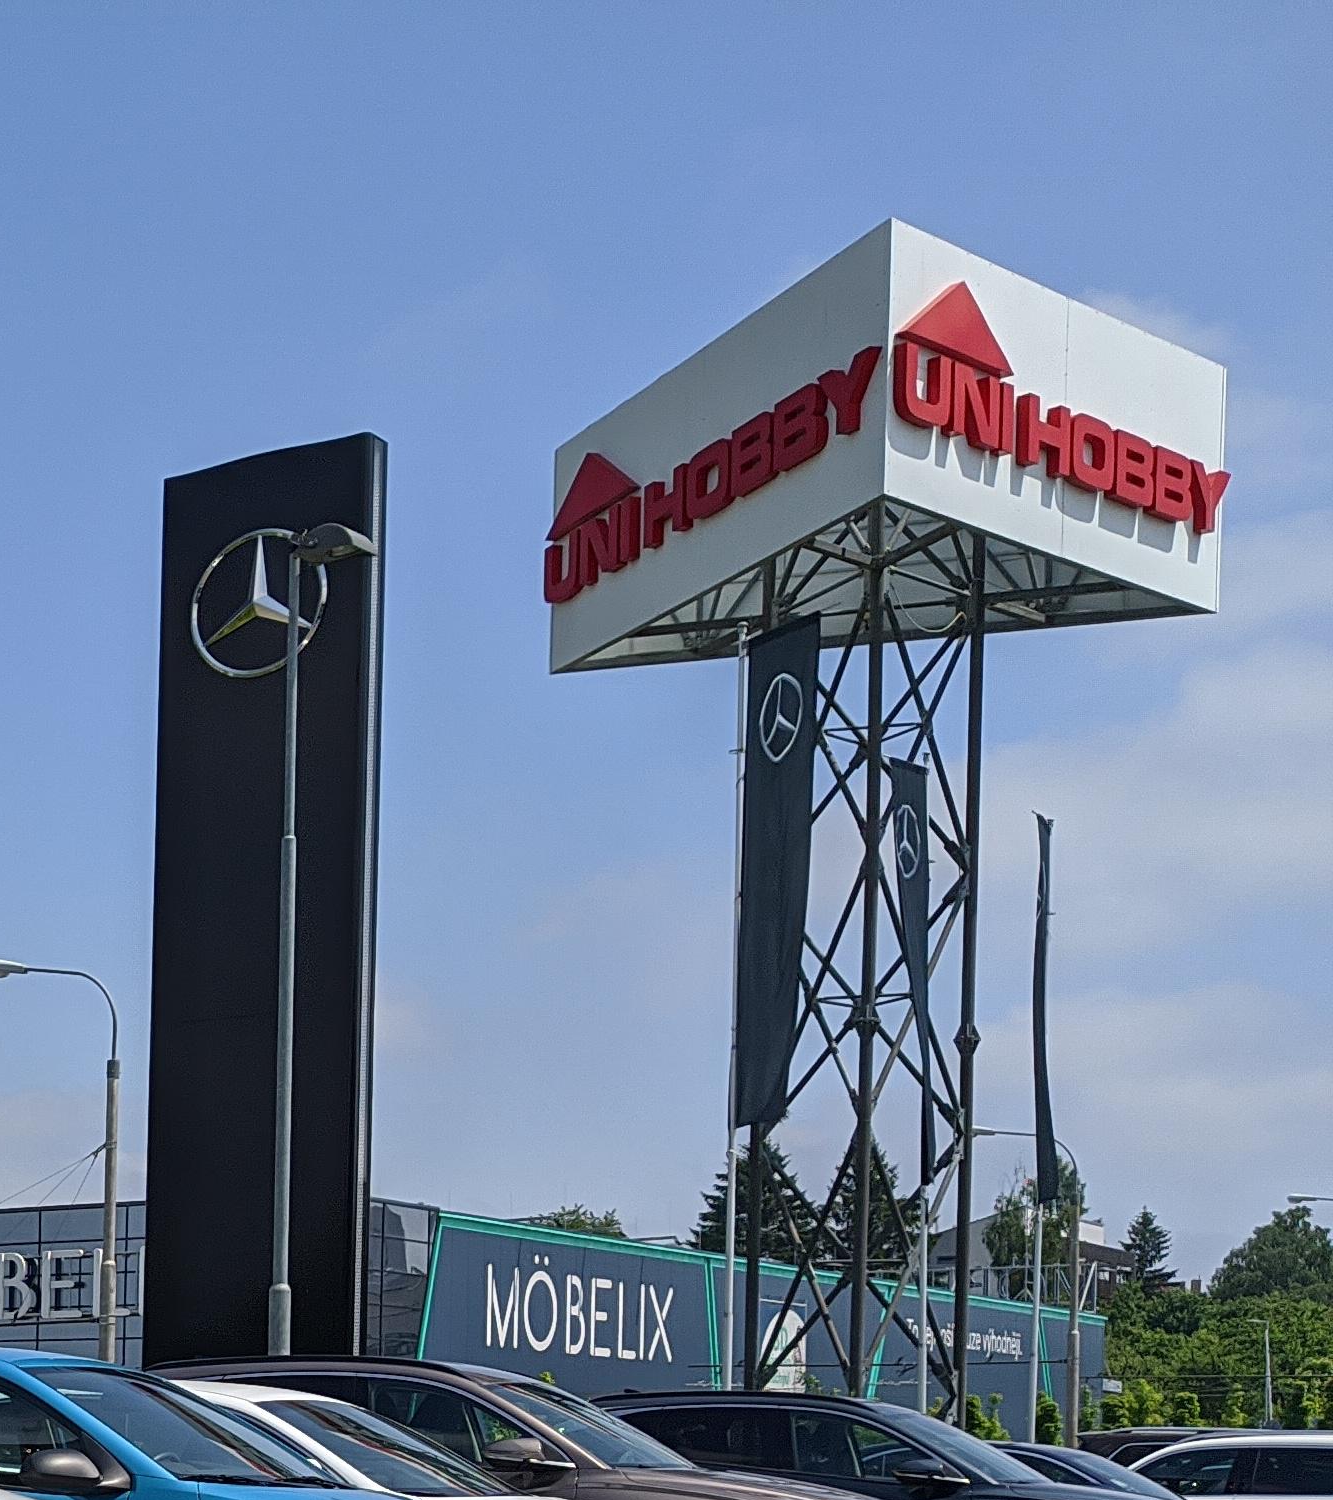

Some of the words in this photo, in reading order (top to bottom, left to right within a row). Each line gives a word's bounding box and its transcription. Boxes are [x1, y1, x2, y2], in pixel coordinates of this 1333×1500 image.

[544, 496, 641, 603] UNI
[643, 346, 882, 549] HOBBY
[893, 342, 1014, 456] UNI
[1015, 392, 1231, 534] HOBBY
[486, 1254, 674, 1363] MÖBELIX
